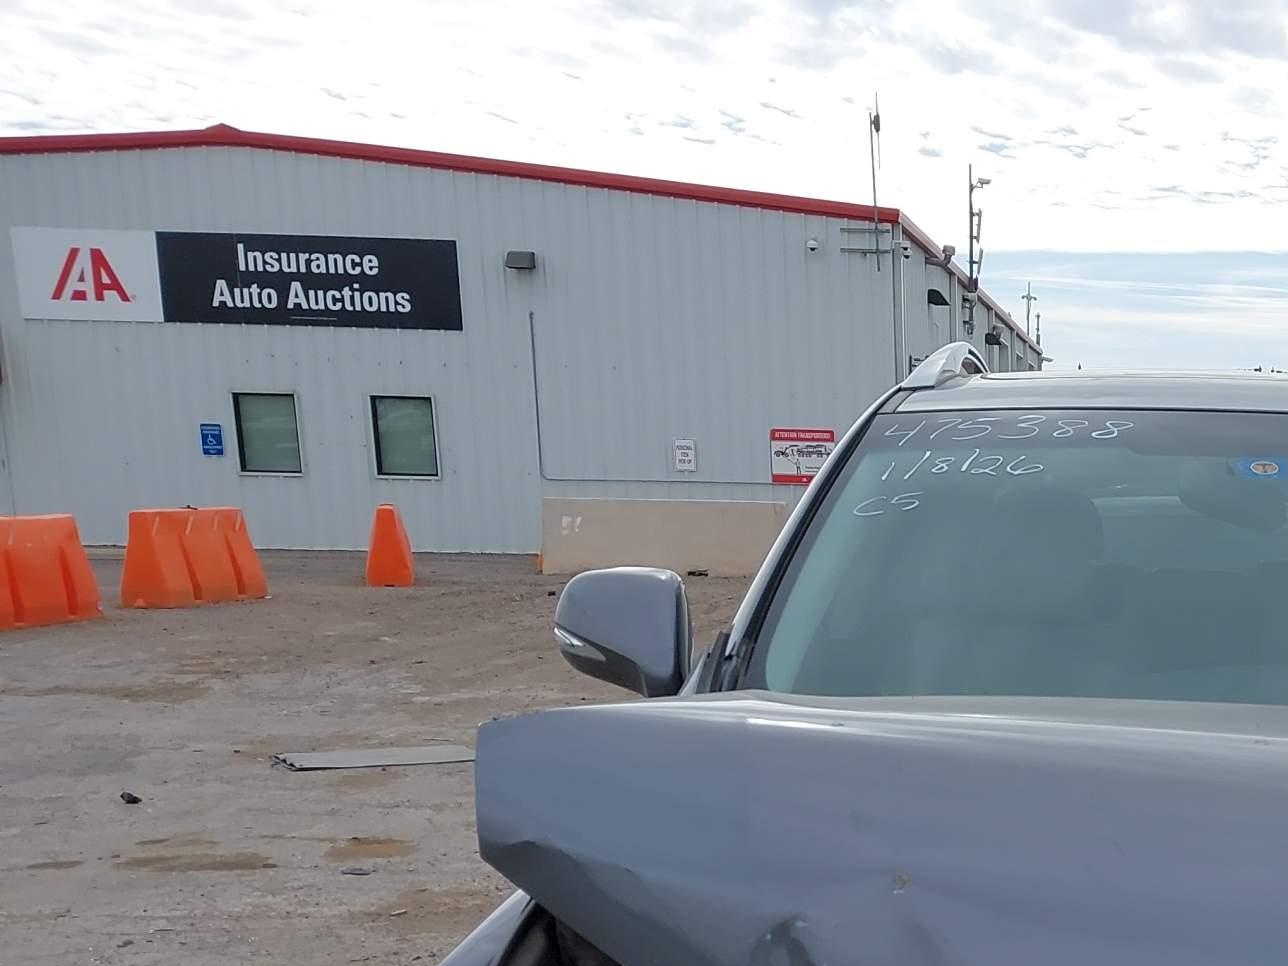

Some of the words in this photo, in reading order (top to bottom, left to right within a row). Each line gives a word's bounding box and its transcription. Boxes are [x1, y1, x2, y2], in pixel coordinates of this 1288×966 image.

[236, 243, 379, 275] Insurance
[212, 279, 278, 309] Auto
[287, 281, 412, 313] Auctions
[884, 415, 1135, 446] 475388
[881, 449, 1044, 481] 1/8/26
